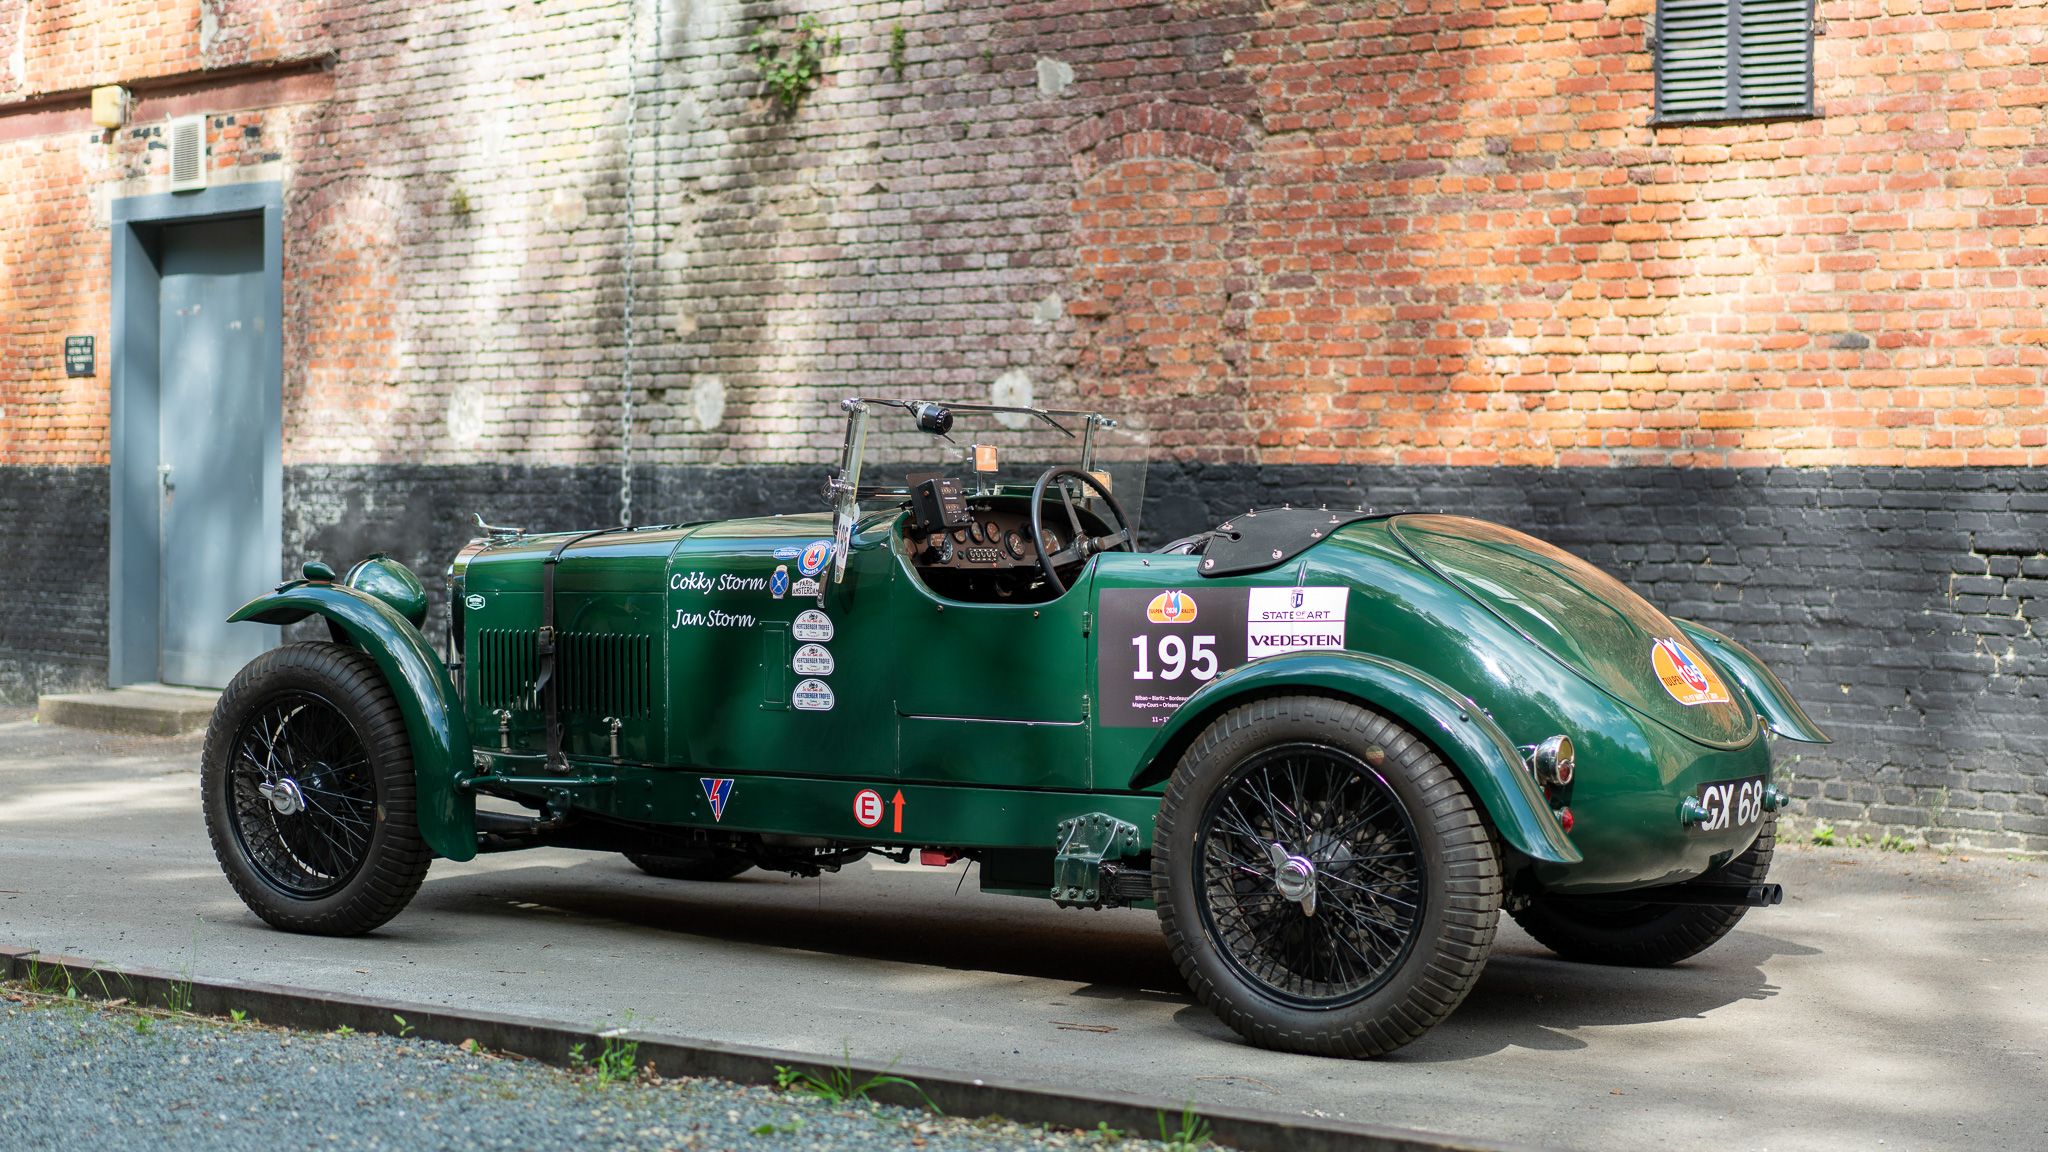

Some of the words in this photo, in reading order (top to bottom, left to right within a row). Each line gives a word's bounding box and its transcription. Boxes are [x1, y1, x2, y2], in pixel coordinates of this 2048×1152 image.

[671, 572, 715, 595] Cokky
[717, 574, 767, 591] Storm
[672, 609, 706, 629] Jan
[707, 610, 756, 627] Storm
[1262, 611, 1294, 620] STATE
[1307, 611, 1331, 619] ART
[1250, 634, 1341, 646] VREDESTEIN
[1132, 634, 1218, 680] 195
[1677, 665, 1705, 683] 195
[862, 797, 875, 819] E
[1701, 786, 1734, 831] GX
[1738, 780, 1763, 826] 68
